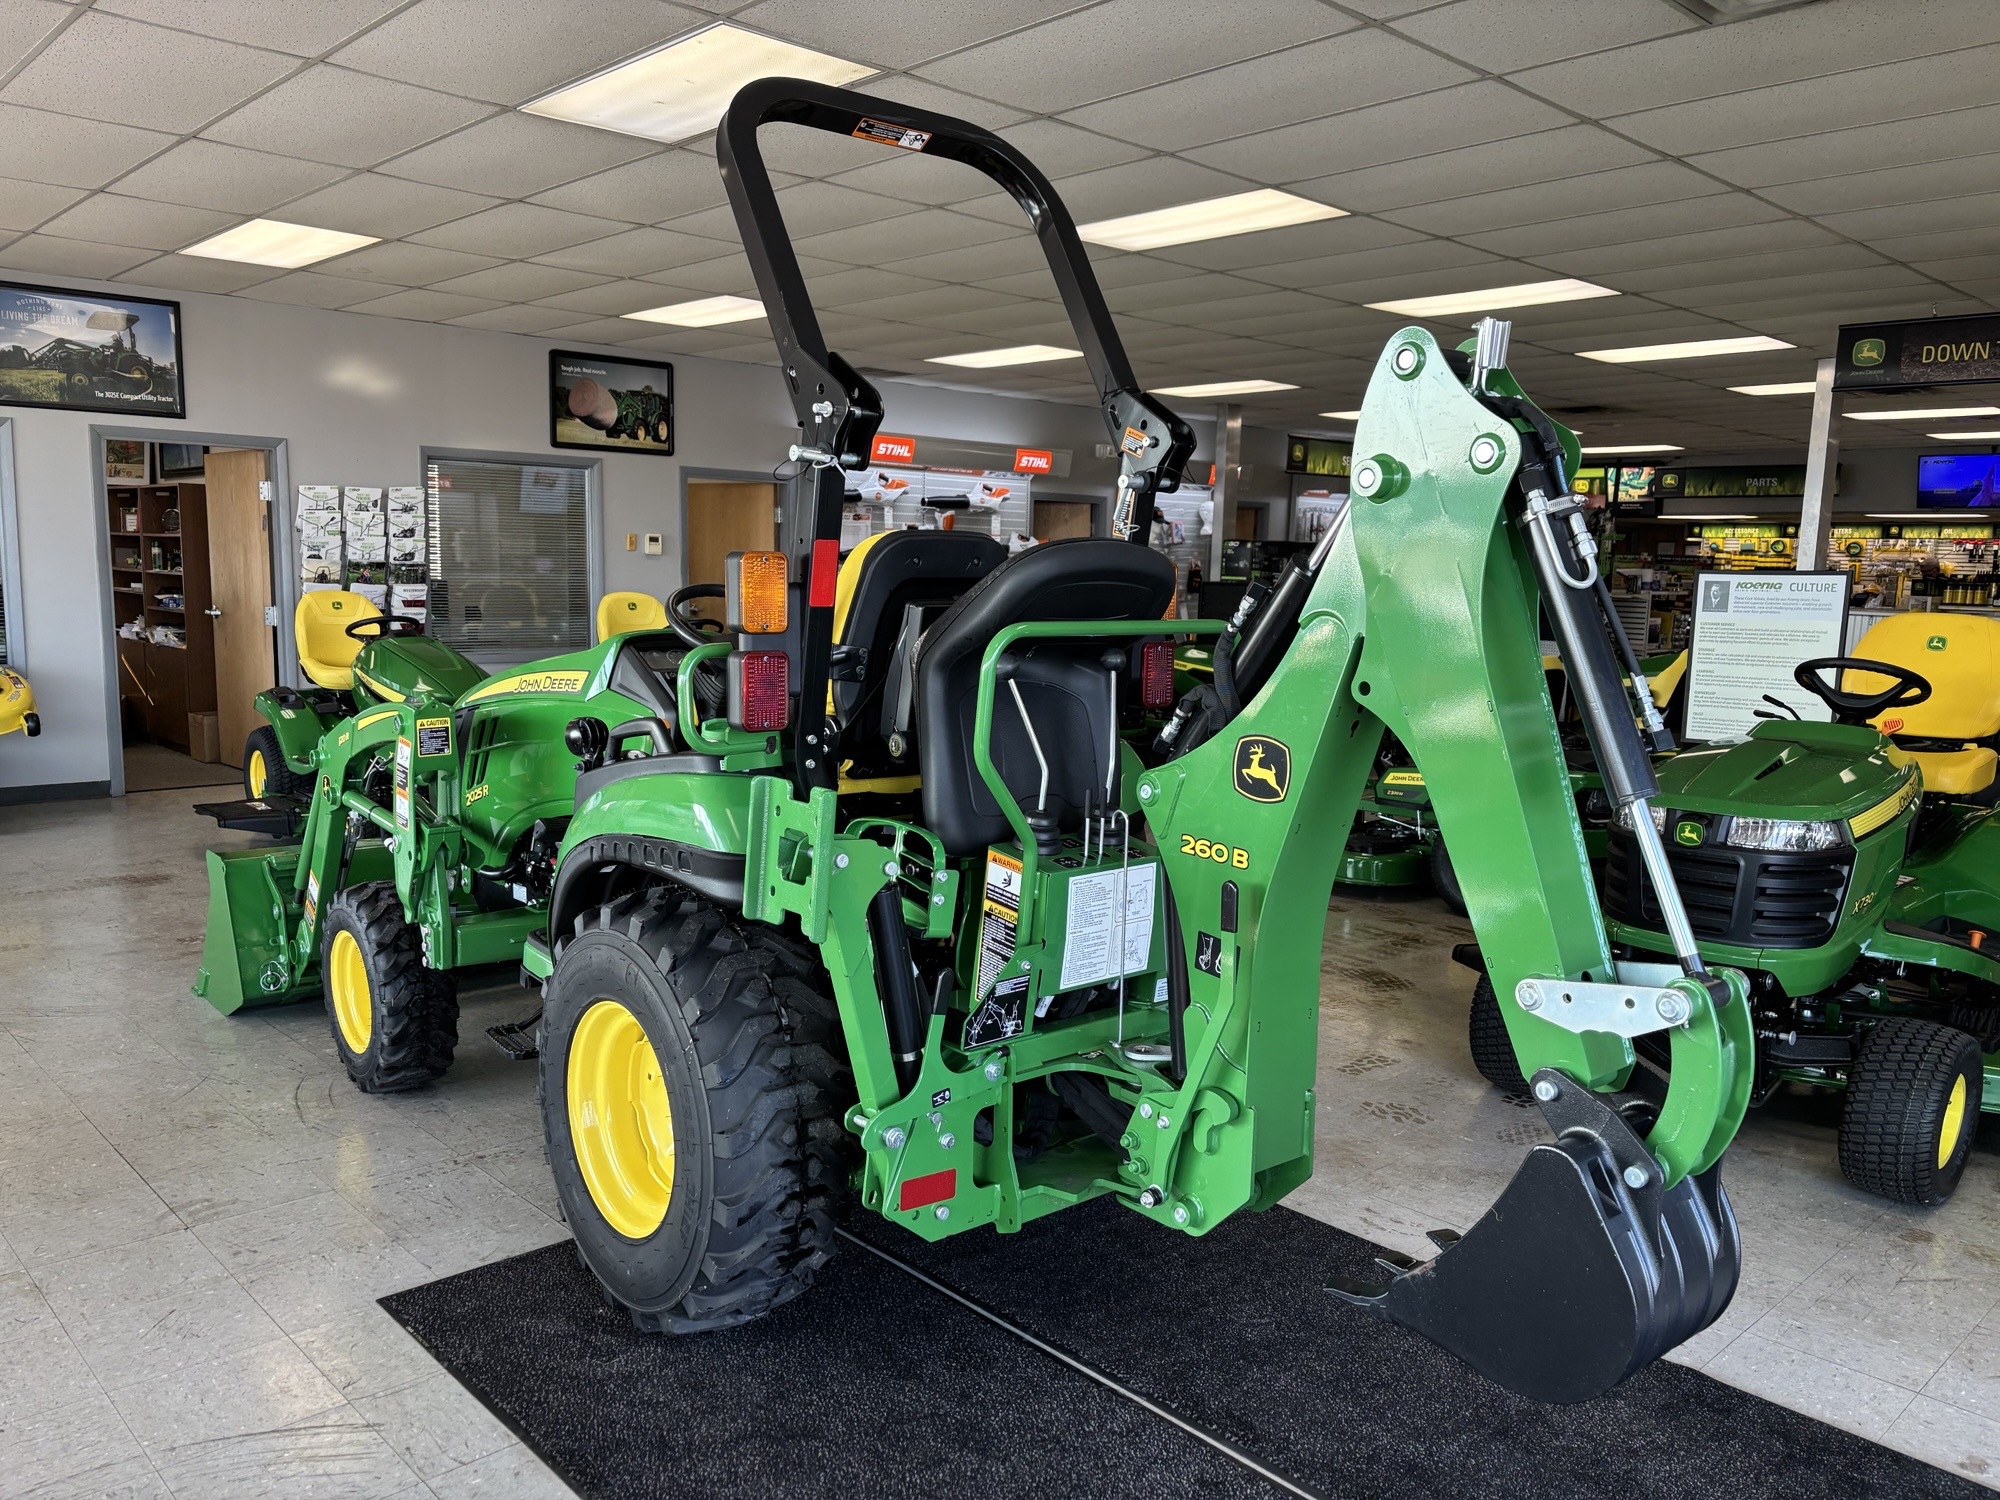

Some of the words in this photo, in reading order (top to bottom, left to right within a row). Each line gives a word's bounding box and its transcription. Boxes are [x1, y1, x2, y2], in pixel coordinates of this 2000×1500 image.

[1, 310, 29, 321] LIVING
[32, 313, 47, 323] THE
[50, 315, 78, 325] DREAM
[1922, 342, 1990, 363] DOWN
[120, 393, 141, 401] Compact
[877, 444, 911, 457] STIHL
[1019, 456, 1049, 468] STIHL
[1746, 478, 1778, 487] PARTS
[1790, 582, 1838, 592] CULTURE
[513, 678, 541, 692] JOHN
[542, 676, 579, 690] DEERE
[1180, 835, 1228, 864] 260
[1231, 847, 1249, 870] B
[1852, 892, 1874, 915] X730
